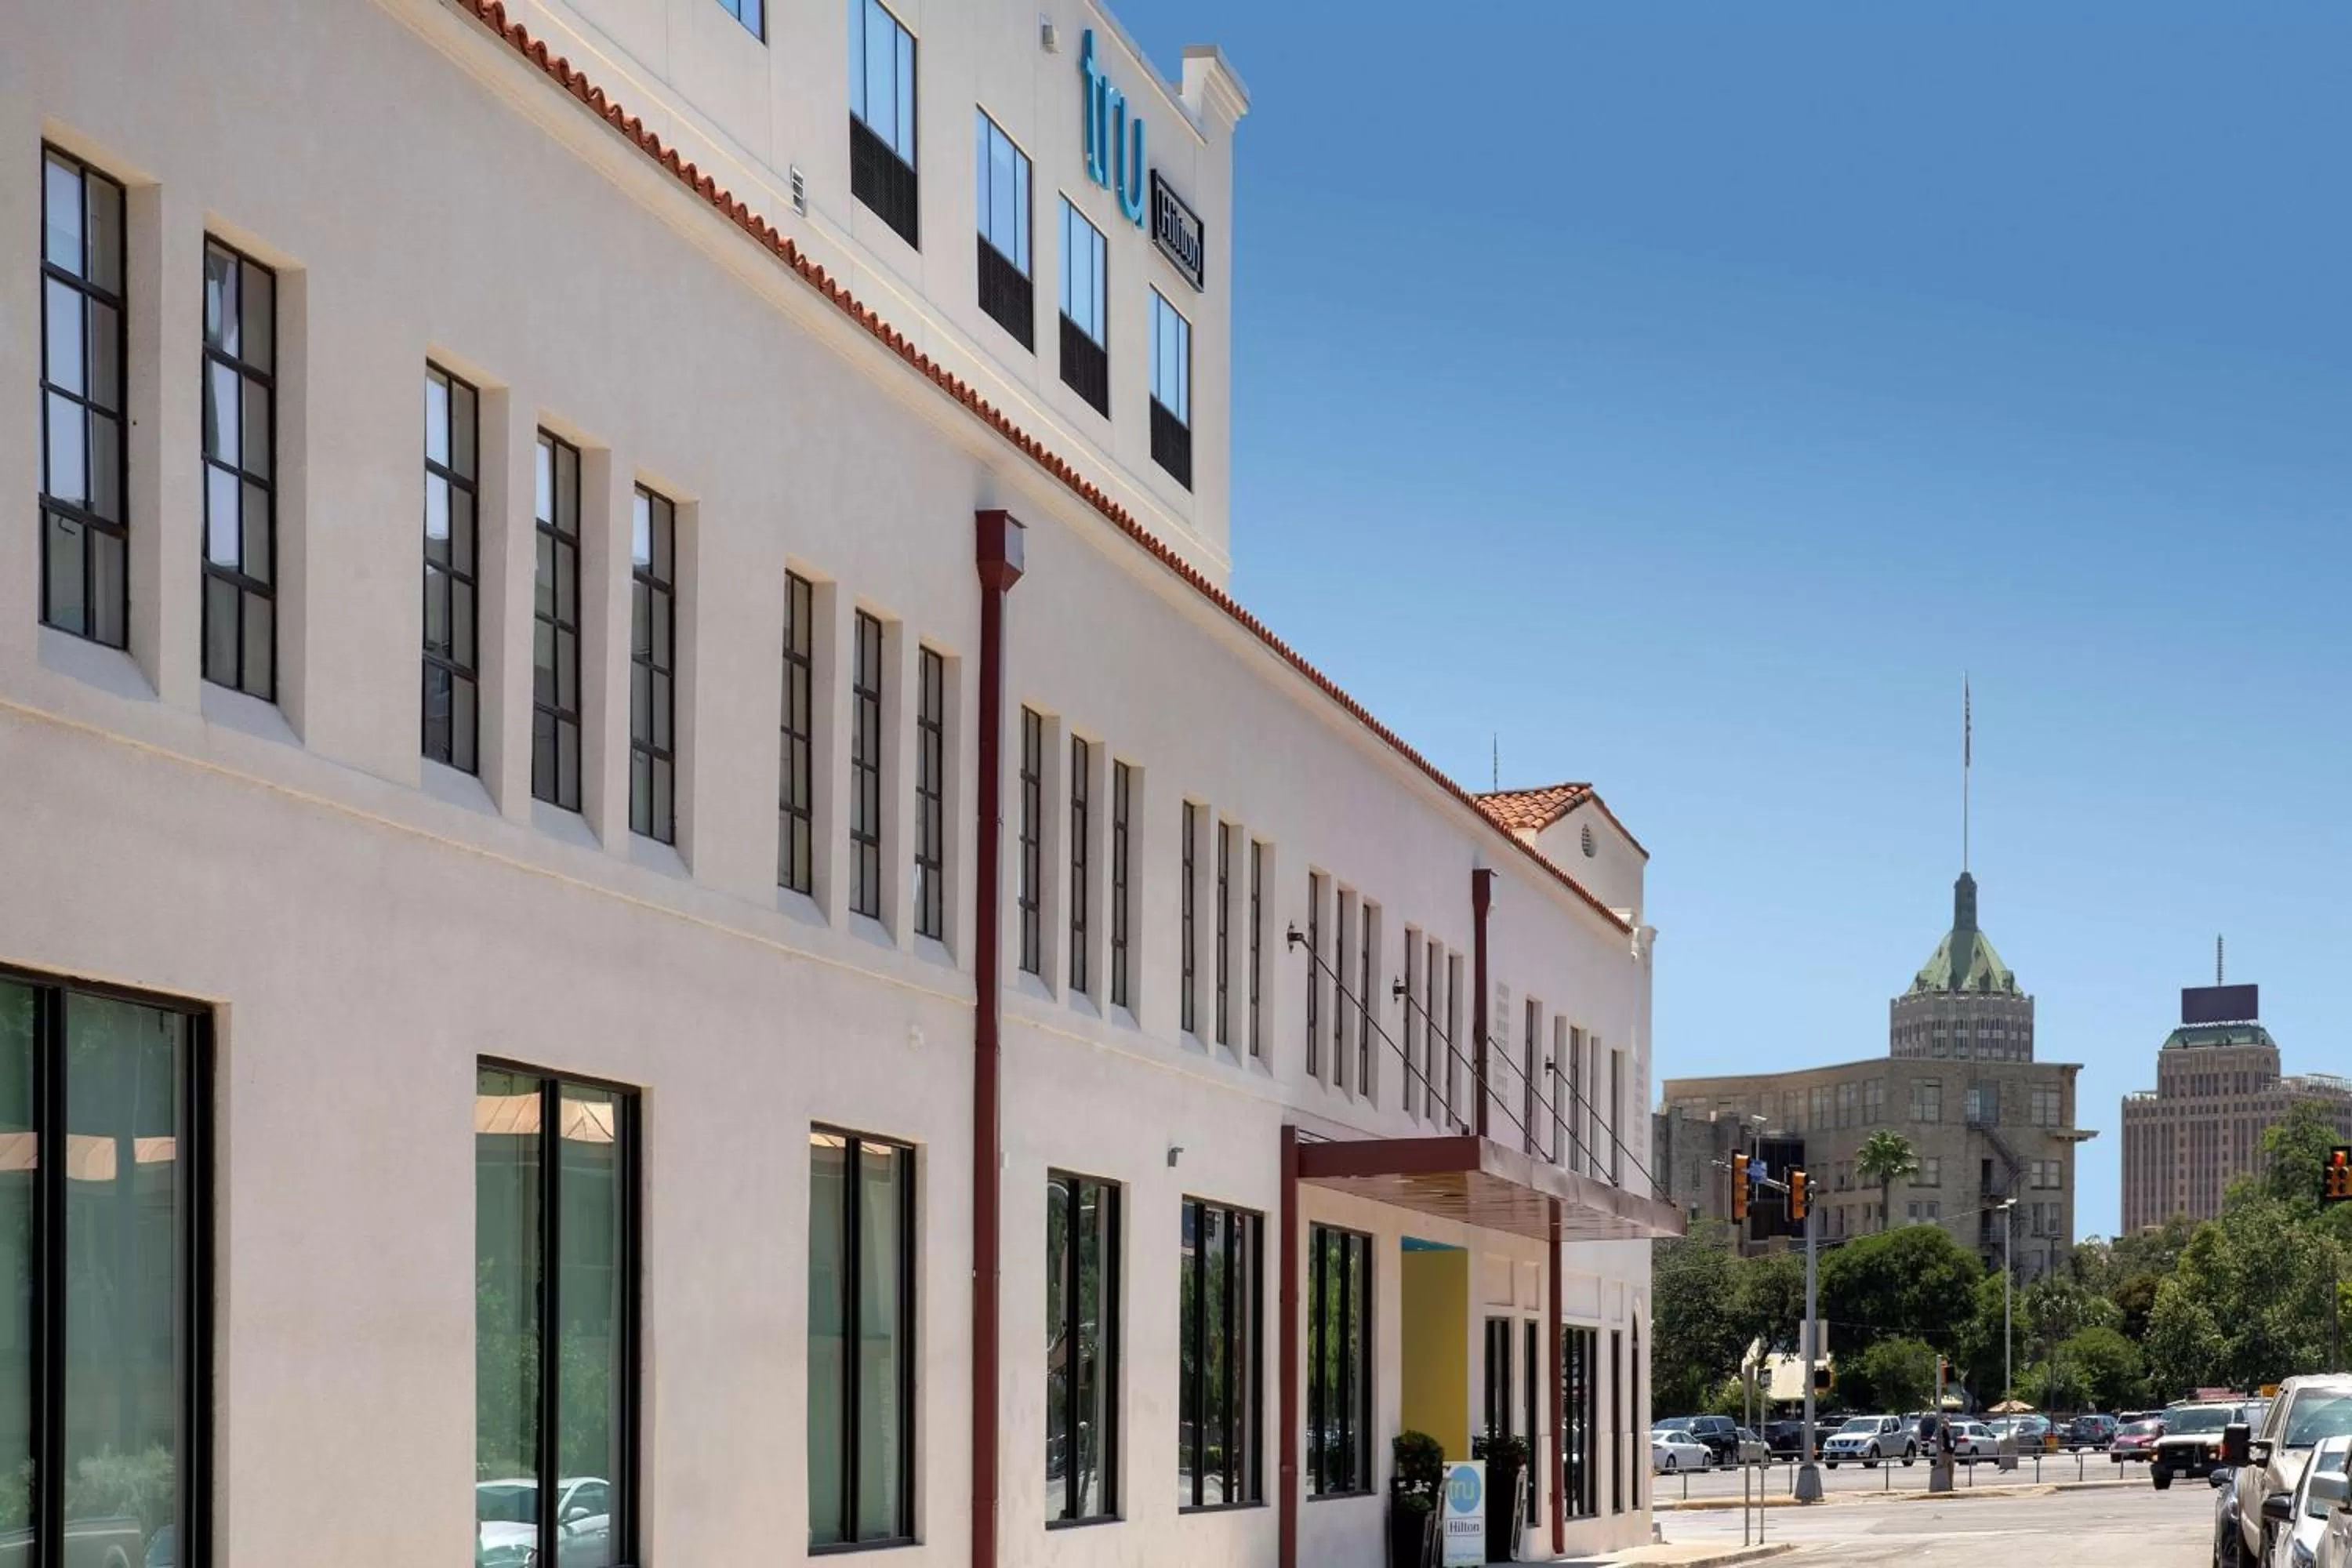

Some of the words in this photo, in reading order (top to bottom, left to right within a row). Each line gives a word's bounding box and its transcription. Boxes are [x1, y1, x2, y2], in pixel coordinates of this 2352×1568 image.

[1080, 29, 1145, 229] tru
[1158, 189, 1201, 273] Hilton
[1448, 1479, 1475, 1501] tru
[1450, 1521, 1479, 1533] Hilton
